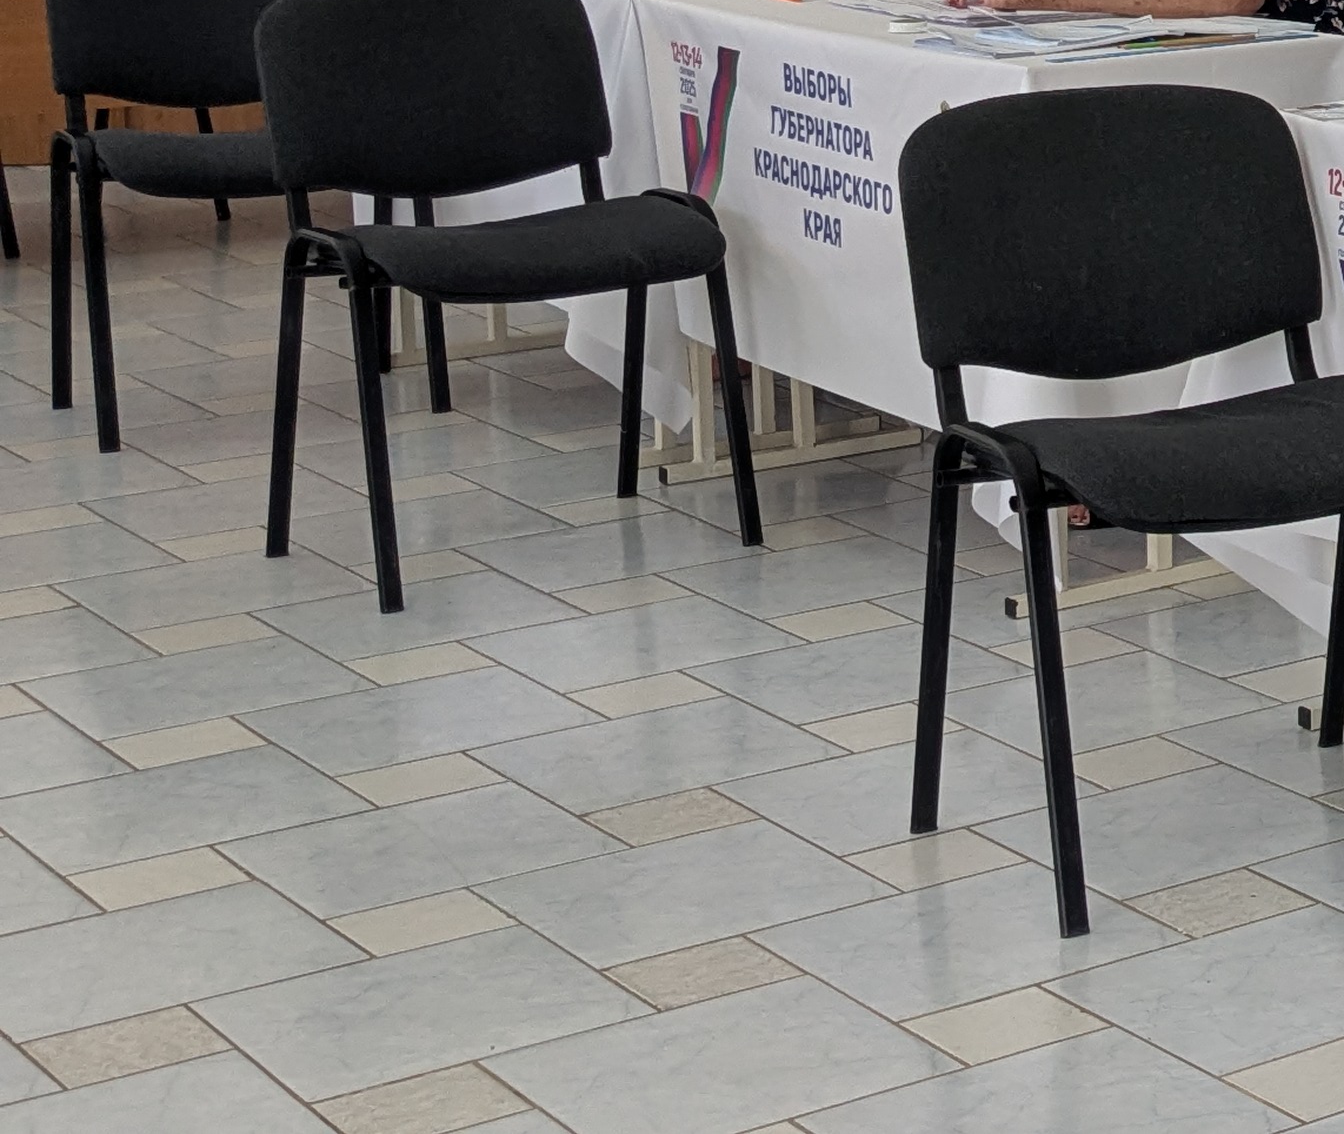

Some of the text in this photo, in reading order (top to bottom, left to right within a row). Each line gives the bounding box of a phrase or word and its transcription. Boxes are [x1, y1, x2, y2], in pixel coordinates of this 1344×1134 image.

[783, 62, 852, 108] ВЫБОРЫ
[771, 105, 874, 162] ГУБЕРНАТОРА
[753, 148, 893, 216] КРАСНОДАРСКОГО
[803, 208, 843, 249] КРАЯ
